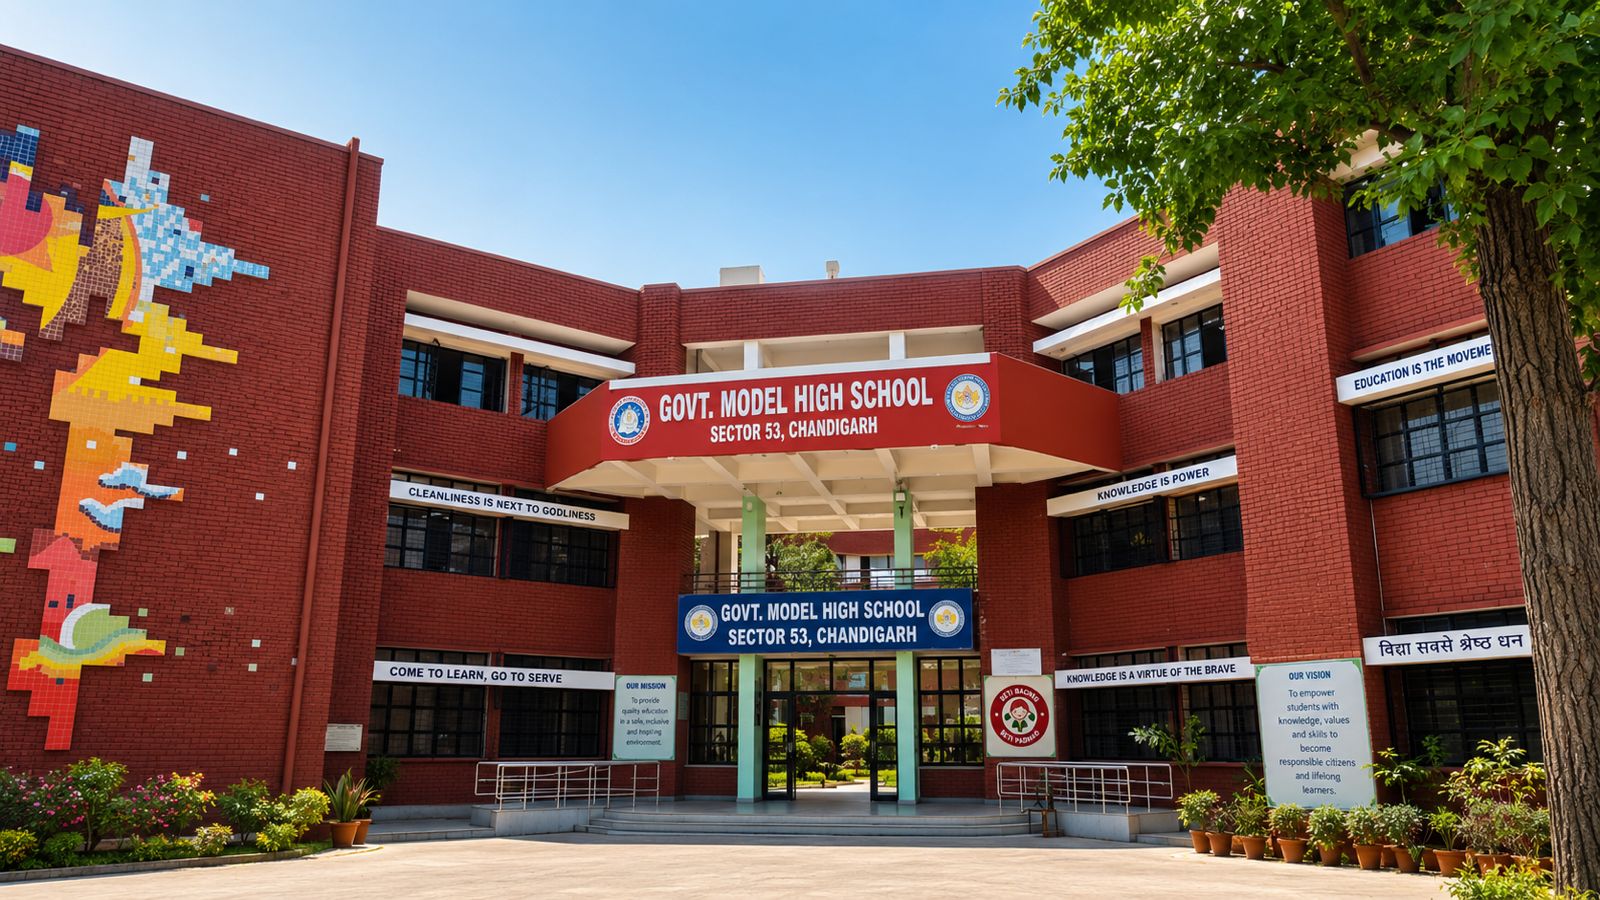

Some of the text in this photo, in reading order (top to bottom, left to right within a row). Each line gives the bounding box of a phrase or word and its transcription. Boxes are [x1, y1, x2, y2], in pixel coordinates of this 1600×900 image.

[1354, 343, 1492, 390] EDUCATION IS THE MOVEME
[659, 391, 714, 423] GOVT.
[720, 384, 788, 418] MODEL
[794, 381, 843, 412] HIGH
[850, 377, 934, 410] SCHOOL
[710, 416, 878, 443] SECTOR 53, CHANDIGARH
[1097, 467, 1210, 501] KNOWLEDGE IS POWER
[408, 487, 596, 521] CLEANLINESS IS NEXT TO GODLINESS
[721, 604, 763, 622] GOVT.
[767, 602, 818, 621] MODEL
[822, 601, 859, 620] HIGH
[863, 600, 925, 619] SCHOOL
[728, 625, 917, 647] SECTOR 53, CHANDIGARH
[1379, 640, 1411, 657] विद्या
[1459, 633, 1492, 651] श्रेष्ठ
[1498, 634, 1523, 648] धन
[390, 666, 563, 683] COME TO LEARN, GO TO SERVE
[1067, 664, 1236, 684] KNOWLEDGE IS A VIRTUE OF THE BRAVE
[1289, 671, 1331, 680] OUR VISION
[640, 682, 666, 690] MISSION
[1289, 689, 1335, 699] To empower
[1287, 702, 1339, 711] students with
[1278, 716, 1350, 726] knowledge, values
[1292, 730, 1338, 739] and skills to
[1300, 743, 1332, 753] become
[1279, 758, 1356, 769] responsible citizens
[1295, 771, 1341, 783] and lifelong
[1302, 785, 1337, 795] learners.
